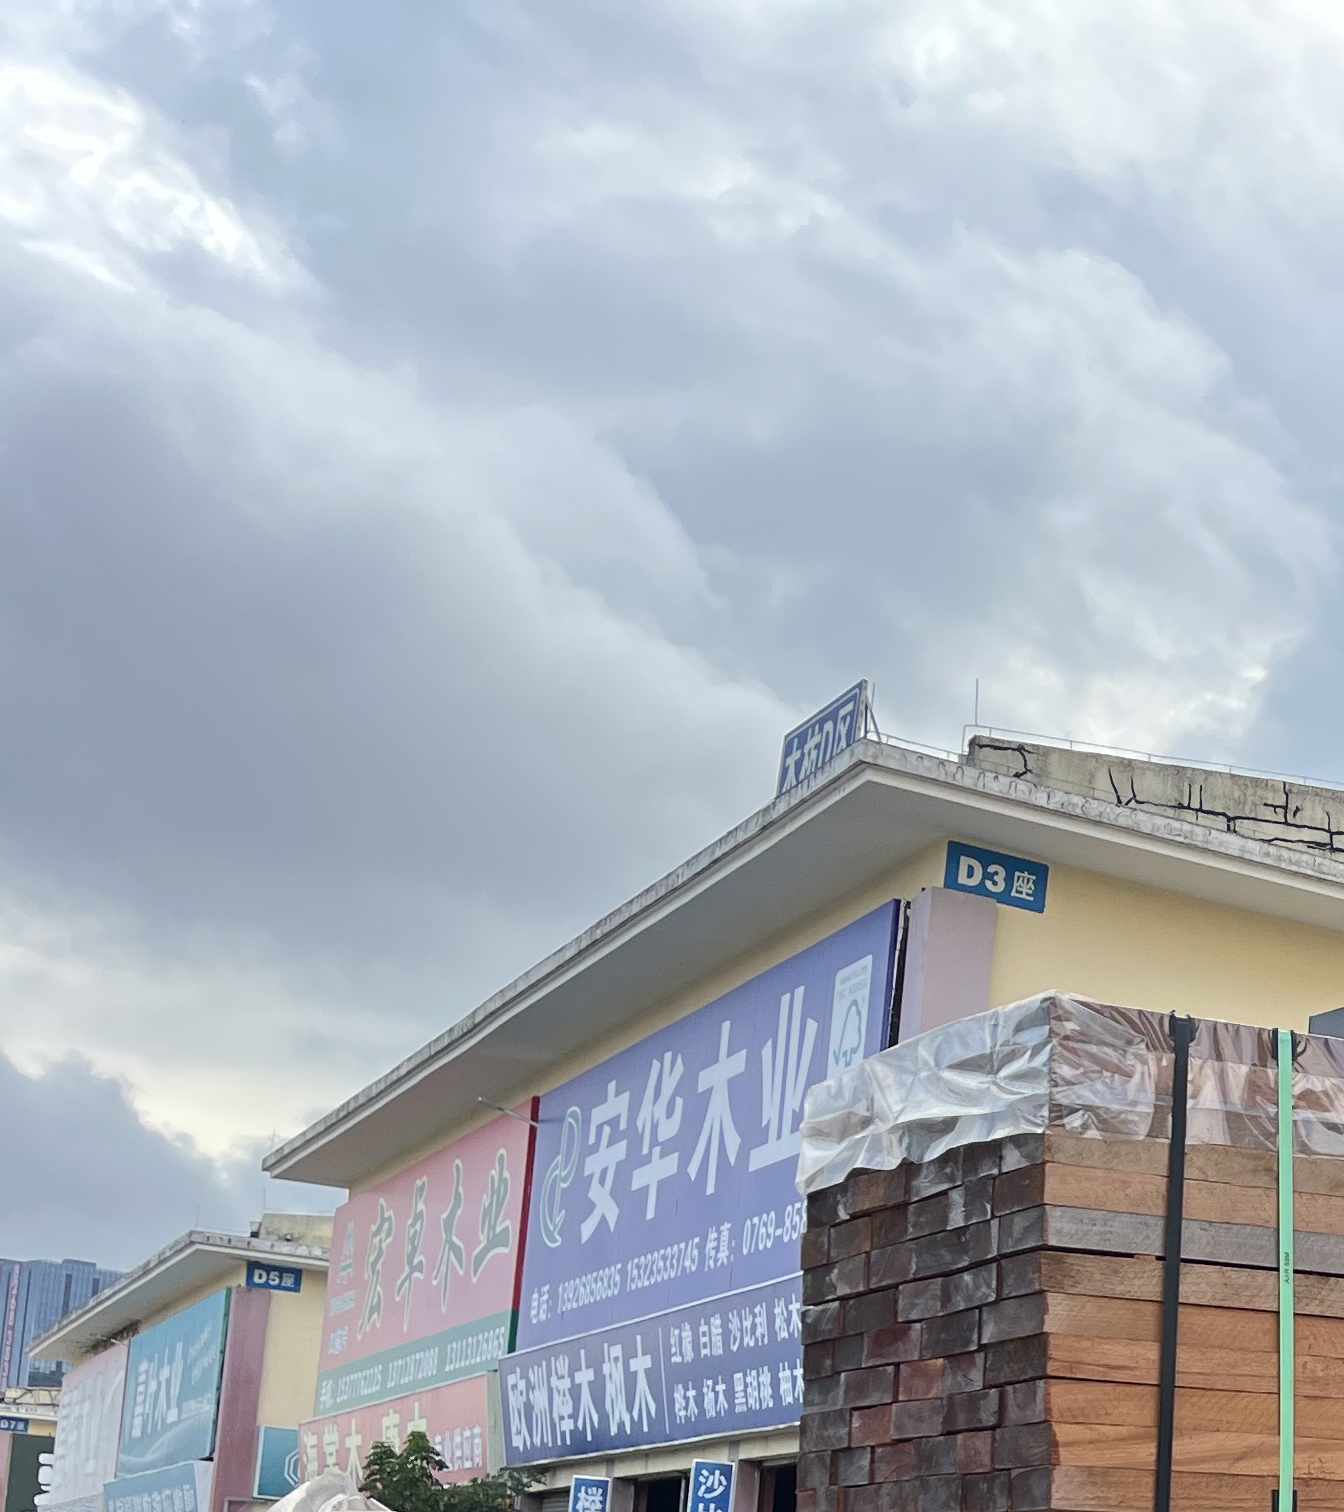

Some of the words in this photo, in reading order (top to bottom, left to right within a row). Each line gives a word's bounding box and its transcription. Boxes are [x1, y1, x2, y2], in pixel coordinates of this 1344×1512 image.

[956, 853, 1037, 903] D3座
[580, 985, 819, 1245] 安华木业
[626, 1237, 700, 1292] 15323533745
[728, 1301, 768, 1352] 沙比利
[774, 1294, 801, 1341] 松木
[734, 1365, 773, 1413] 黑胡桃
